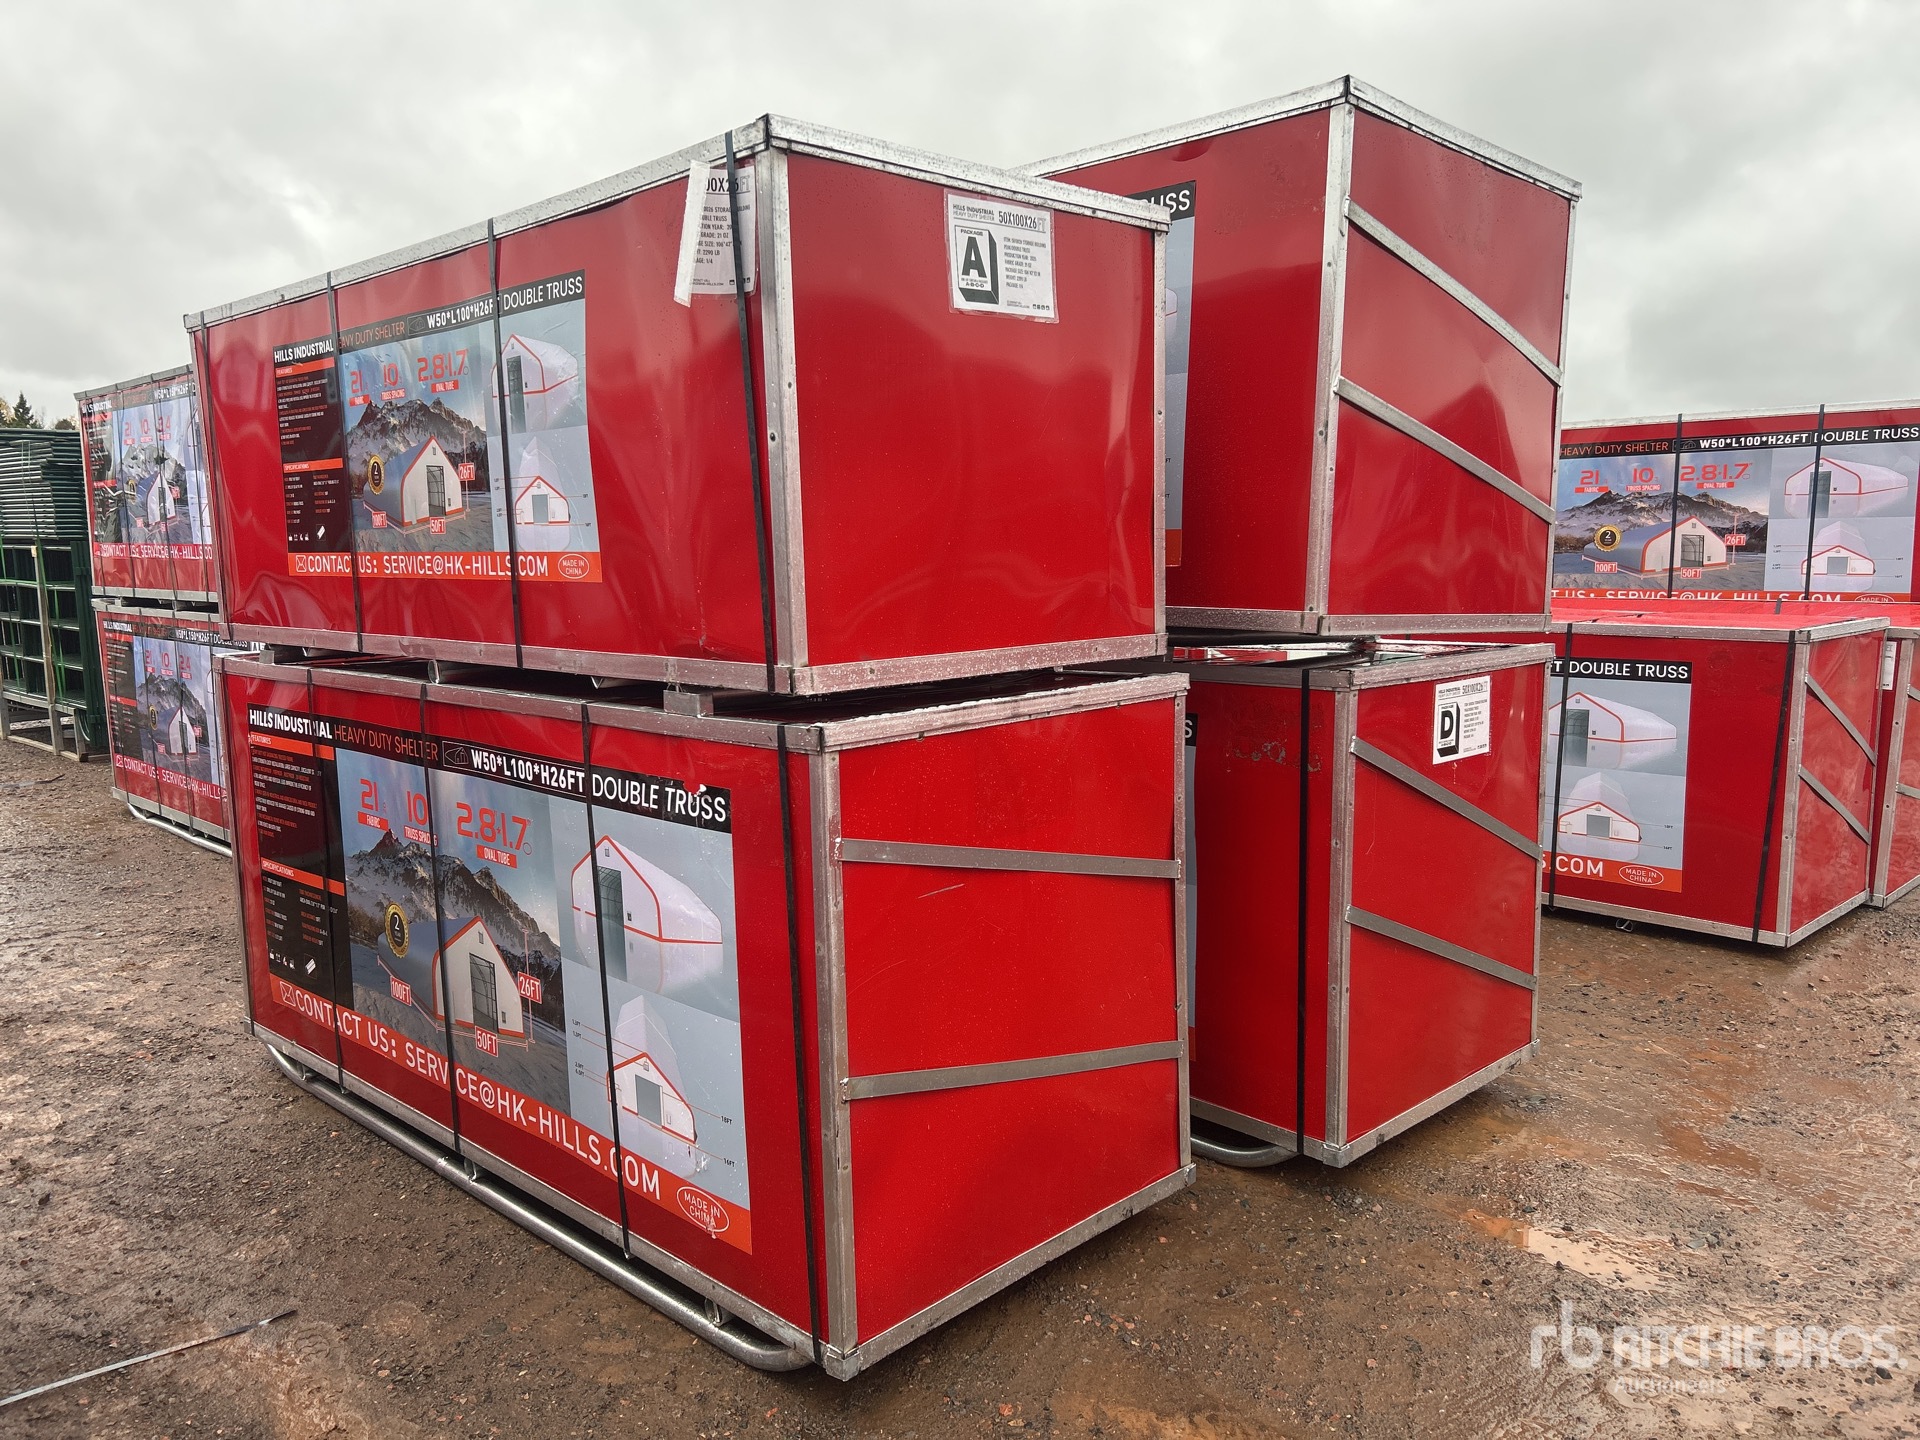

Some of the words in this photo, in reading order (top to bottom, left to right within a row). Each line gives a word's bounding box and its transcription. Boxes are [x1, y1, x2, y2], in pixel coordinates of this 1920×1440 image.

[966, 206, 995, 217] INDUSTRIAL
[998, 210, 1038, 230] 50X100X26
[960, 228, 984, 236] PACKAGE
[961, 236, 987, 279] A
[503, 285, 544, 311] DOUBLE
[546, 276, 583, 301] TRUSS
[355, 329, 374, 344] DUTY
[375, 321, 406, 341] SHELTER
[274, 347, 293, 363] HILLS
[294, 339, 334, 360] INDUSTRIAL
[350, 369, 363, 394] 21
[383, 363, 399, 387] 10
[1873, 426, 1920, 440] TRUSS
[1559, 446, 1591, 457] HEAVY
[1594, 444, 1622, 455] DUTY
[1625, 441, 1669, 453] SHELTER
[459, 464, 474, 480] 26FT
[1580, 470, 1600, 485] 21
[1633, 467, 1654, 483] 10
[372, 513, 387, 527] 100FT
[430, 519, 446, 533] 50FT
[1605, 531, 1611, 539] 2
[1726, 535, 1745, 545] 26FT
[358, 555, 378, 574] US:
[562, 559, 577, 567] MADE
[565, 567, 582, 575] CHINA
[1595, 563, 1617, 573] 100FT
[1682, 568, 1701, 579] 50FT
[1569, 660, 1631, 676] DOUBLE
[1635, 663, 1689, 680] TRUSS
[249, 709, 274, 729] HILLS
[1440, 709, 1454, 740] D
[334, 724, 367, 746] HEAVY
[368, 731, 392, 752] DUTY
[394, 736, 439, 761] SHELTER
[360, 778, 379, 812] 21
[592, 773, 659, 810] DOUBLE
[664, 786, 727, 823] TRUSS
[406, 790, 429, 827] 10
[404, 826, 419, 841] TRUSS
[483, 847, 497, 862] OVAL
[497, 850, 510, 866] TUBE
[1625, 867, 1647, 877] MADE
[1629, 874, 1653, 884] CHINA
[394, 914, 400, 931] 2
[391, 979, 410, 1003] 100FT
[519, 976, 541, 1001] 26FT
[477, 1030, 498, 1055] 50FT
[295, 989, 362, 1040] CONTACT
[368, 1021, 396, 1058] US:
[405, 1041, 661, 1200] SERVCE@HK-HILLS.COM
[683, 1190, 708, 1213] MADE
[710, 1204, 721, 1219] IN
[689, 1204, 717, 1228] CHINA
